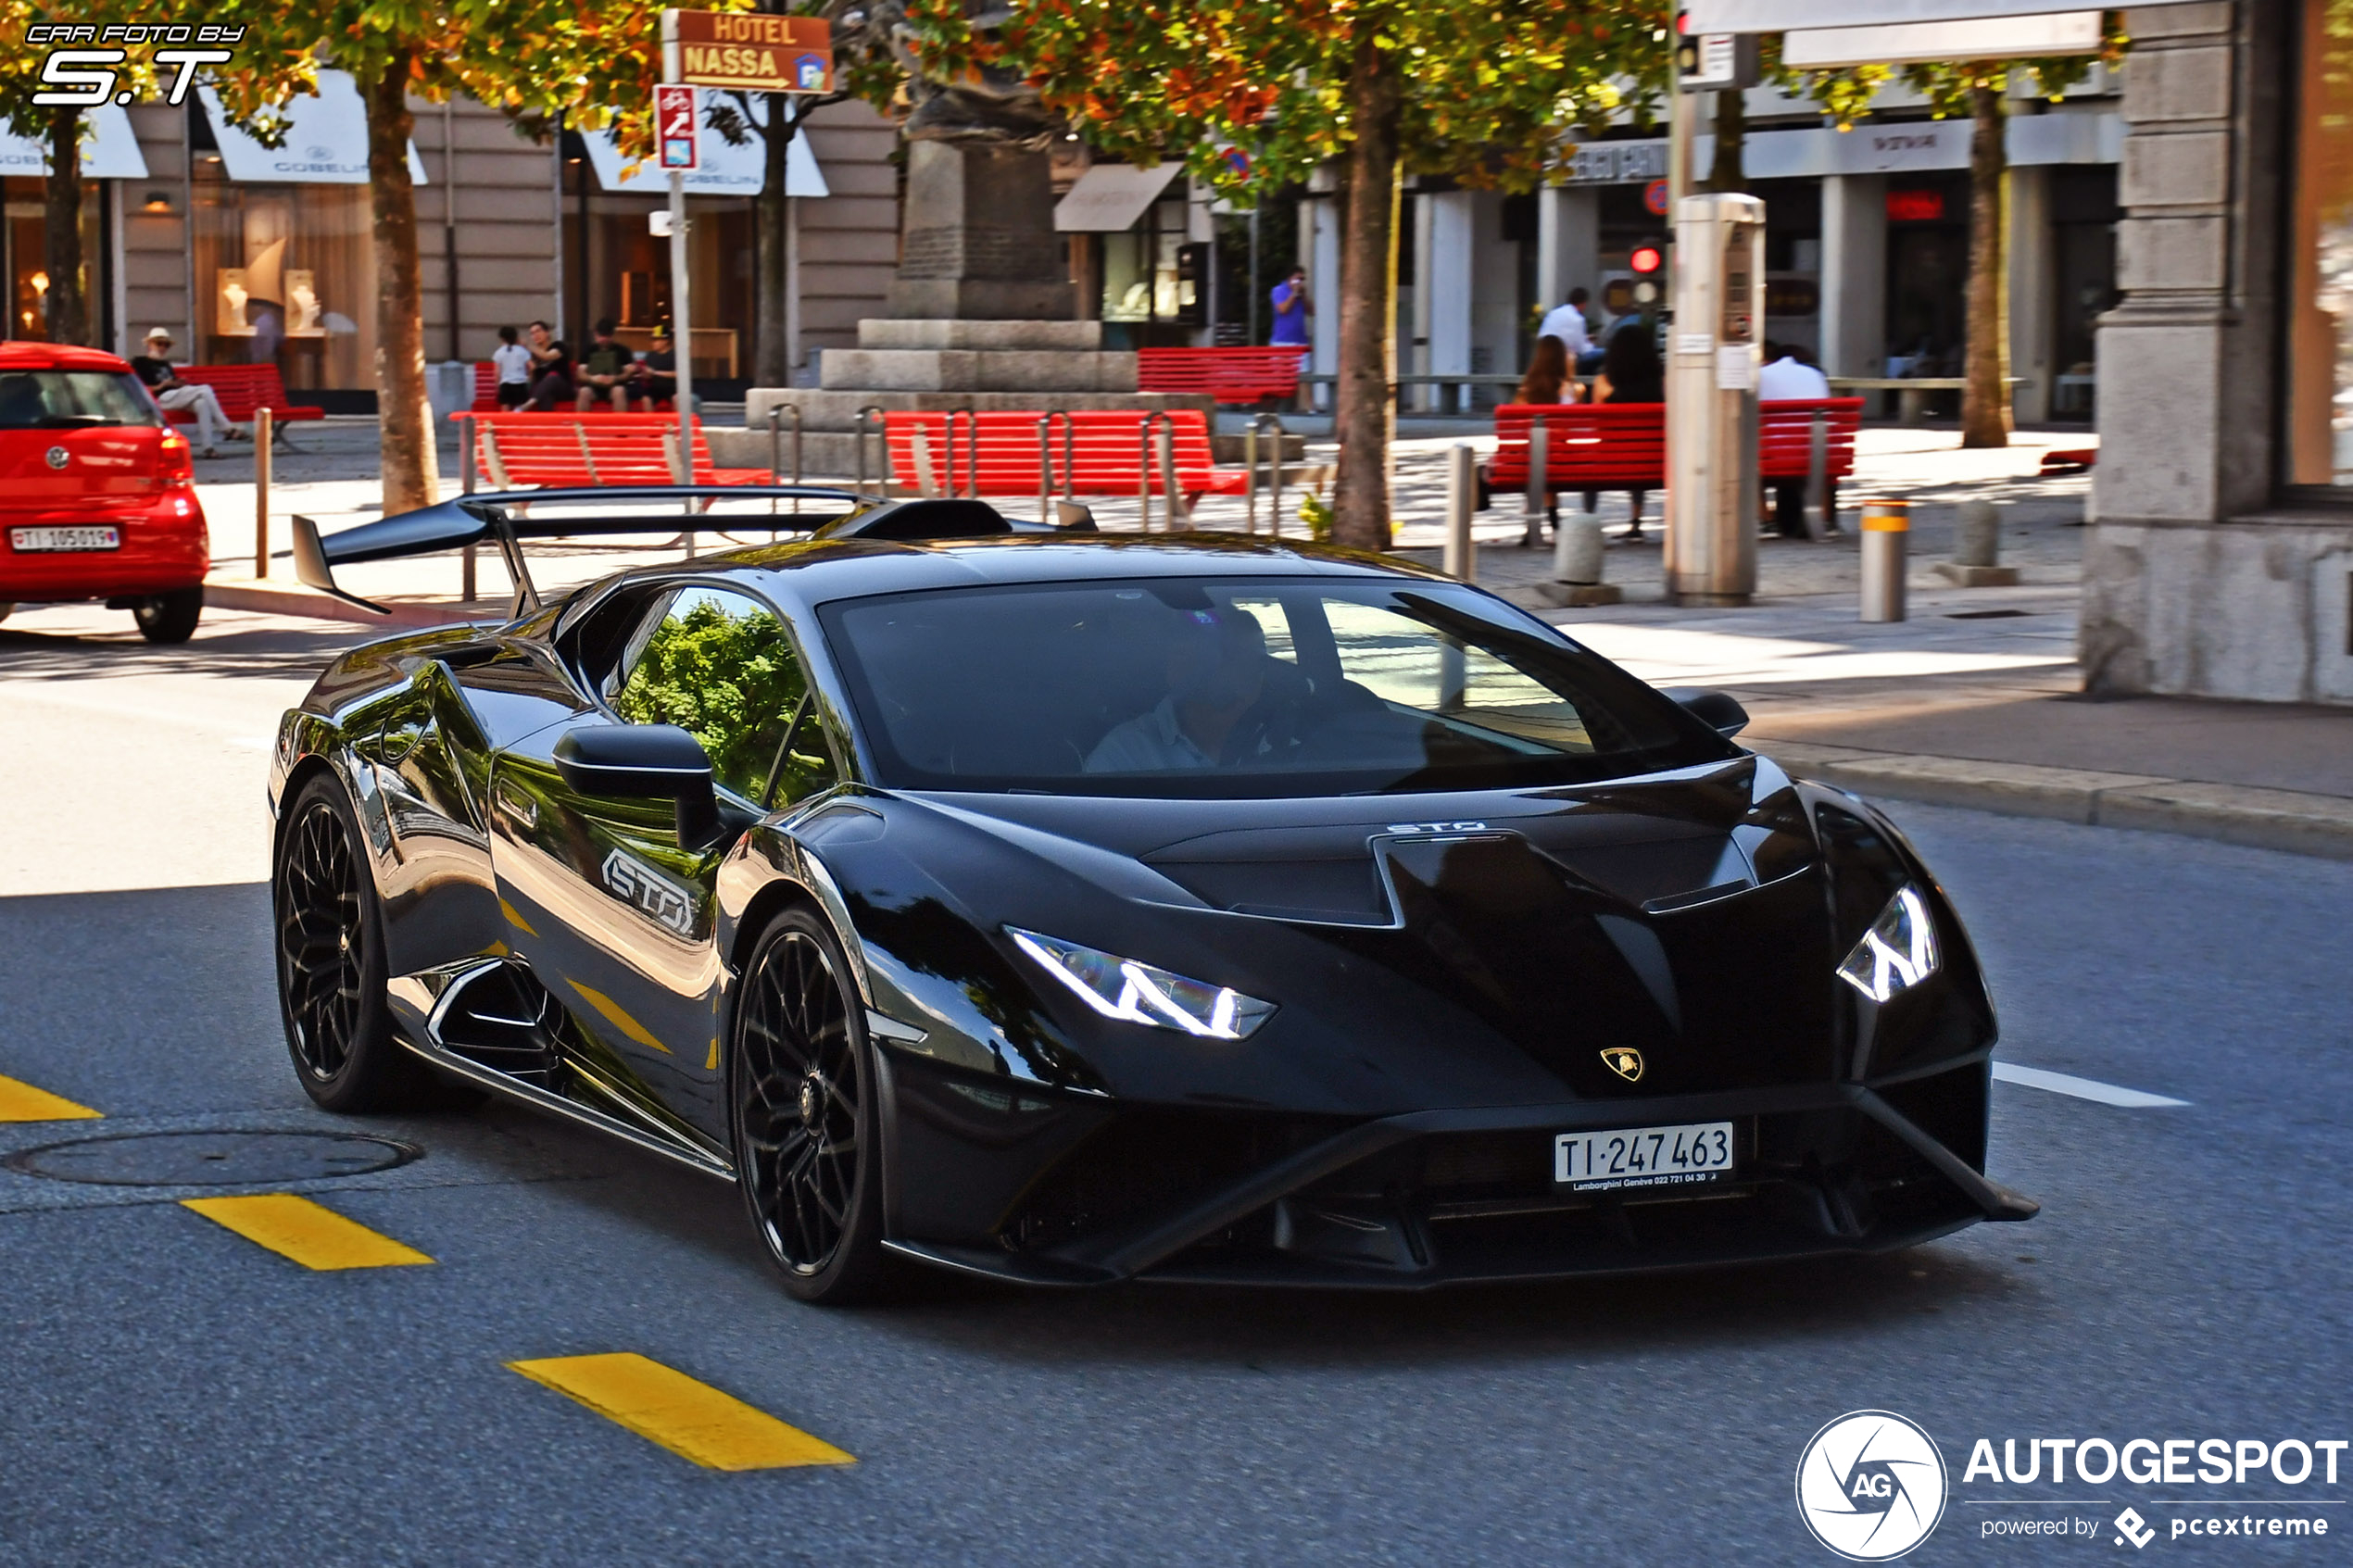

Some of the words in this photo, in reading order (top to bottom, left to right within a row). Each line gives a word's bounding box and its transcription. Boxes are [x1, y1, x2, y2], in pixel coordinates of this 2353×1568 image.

[714, 16, 798, 44] HOTEL
[685, 47, 777, 76] NASSA
[1387, 822, 1486, 834] STO
[610, 859, 685, 929] STO
[1573, 1180, 1622, 1192] Lamborghini
[1654, 1176, 1668, 1185] 022
[1669, 1174, 1684, 1185] 721
[1684, 1173, 1695, 1183] 04
[1695, 1173, 1706, 1183] 30
